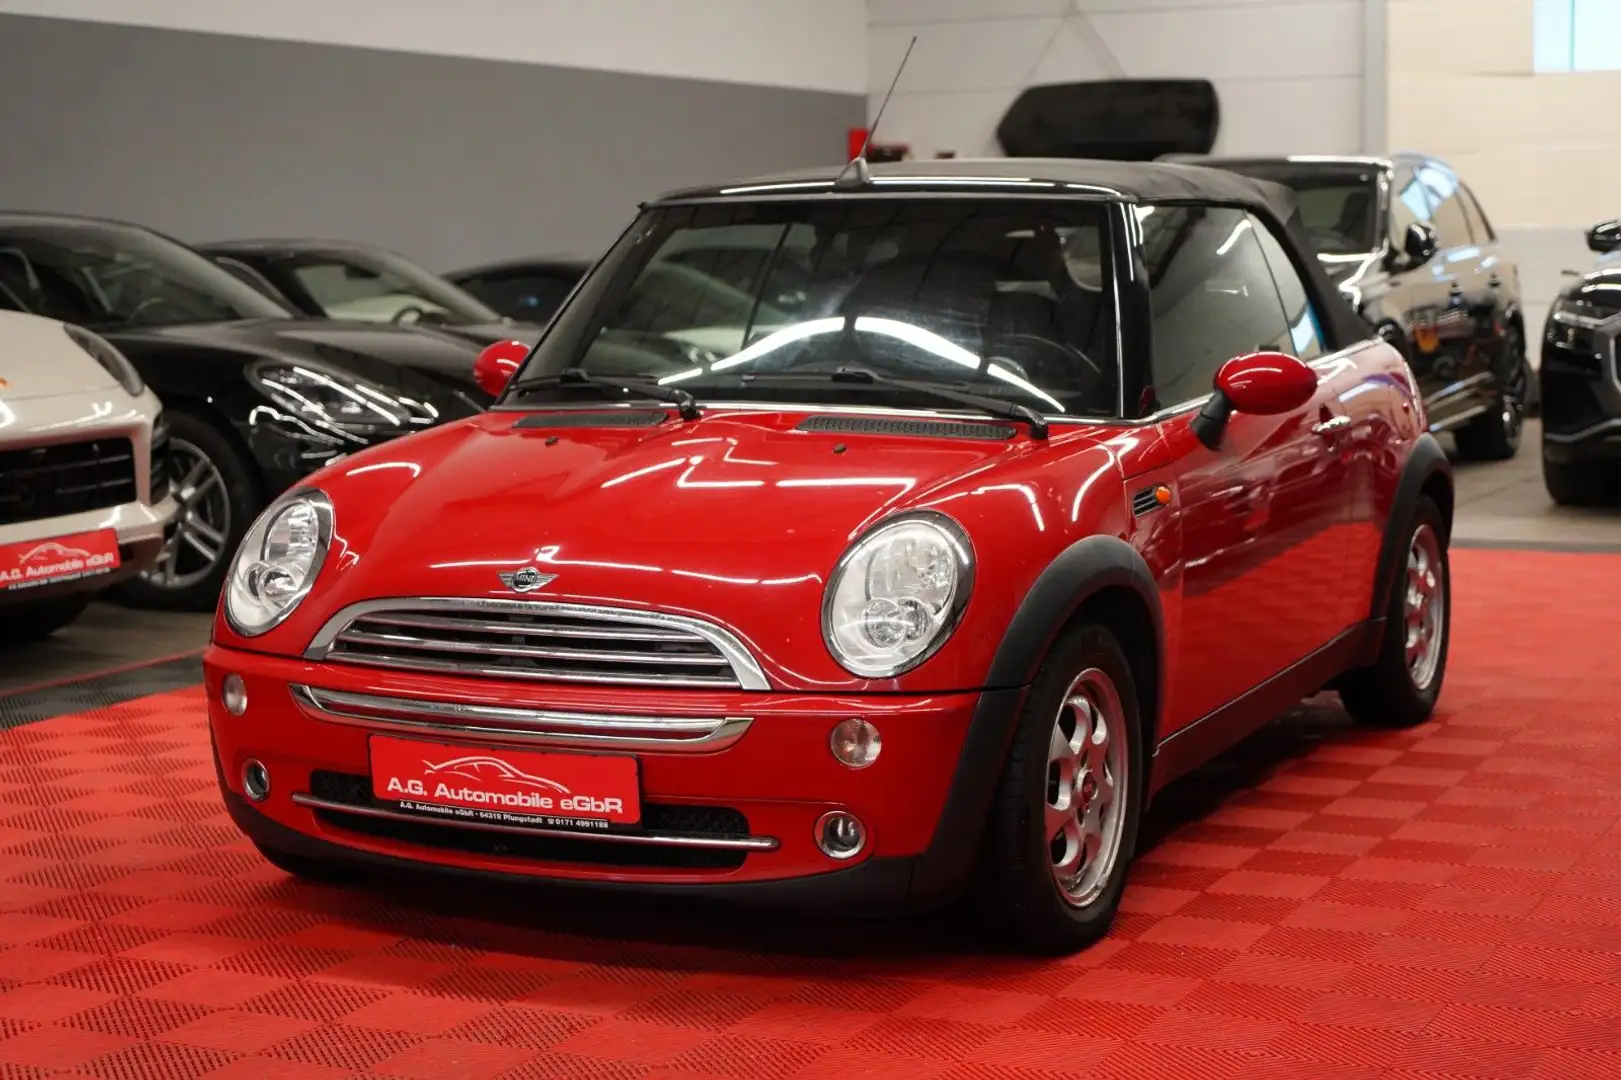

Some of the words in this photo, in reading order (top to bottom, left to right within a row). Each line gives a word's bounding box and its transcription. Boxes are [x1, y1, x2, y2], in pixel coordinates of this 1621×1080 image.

[26, 559, 84, 577] Automobile
[516, 574, 535, 583] MINI
[387, 777, 428, 797] A.G.
[434, 783, 553, 809] Automobile
[560, 795, 624, 814] eGbR
[400, 801, 414, 809] A.G.
[416, 804, 453, 815] Automobile
[455, 808, 474, 817] eGbR
